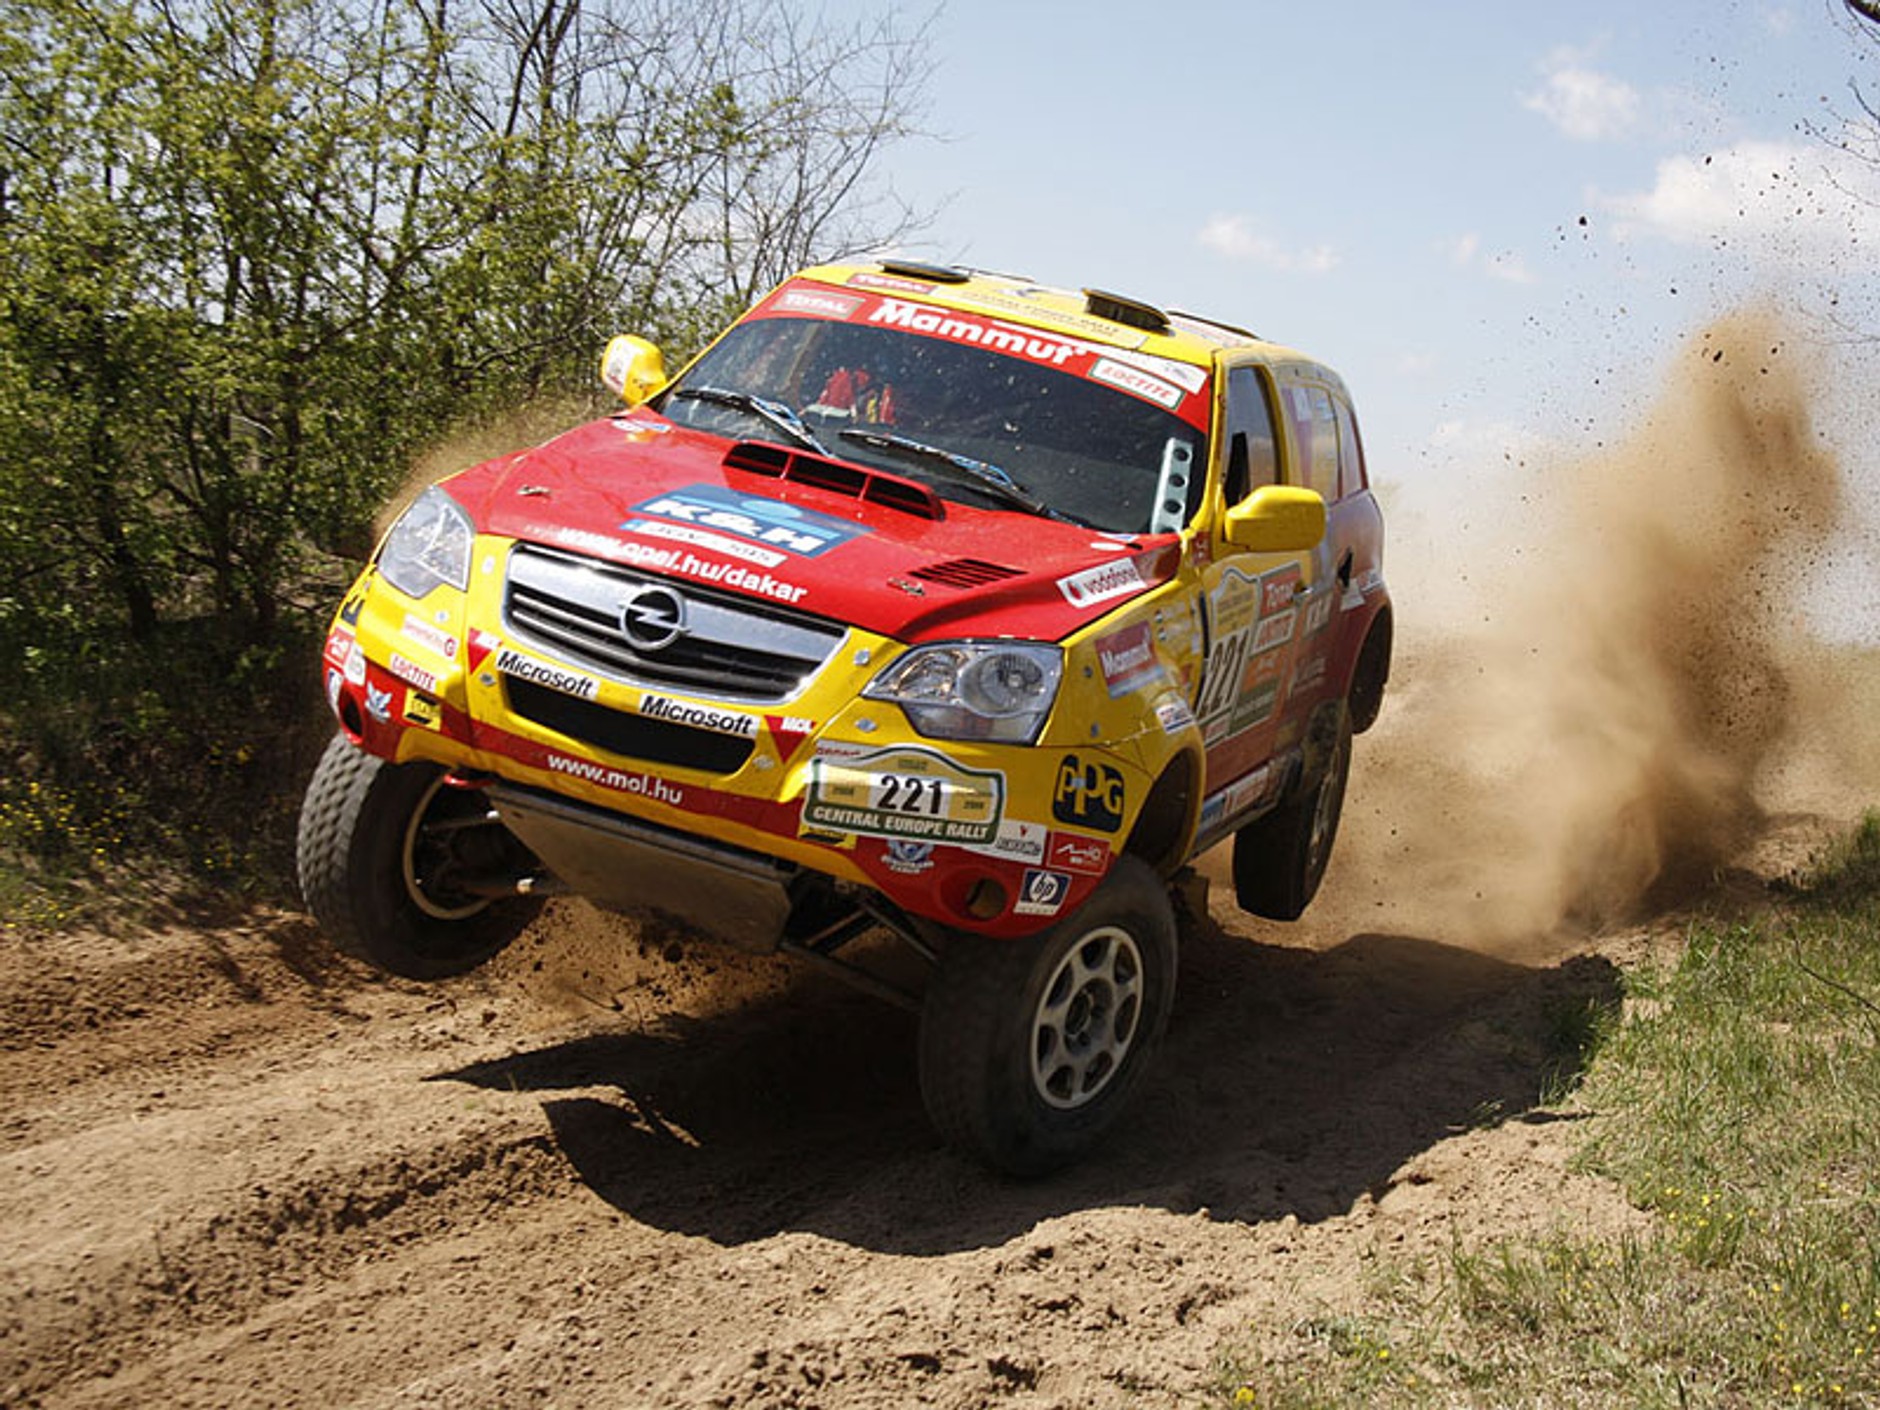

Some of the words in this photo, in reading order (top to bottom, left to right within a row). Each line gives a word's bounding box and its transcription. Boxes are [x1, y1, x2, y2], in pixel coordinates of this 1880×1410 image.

[785, 293, 848, 313] TOTAL
[868, 299, 1087, 365] Mammut
[1101, 366, 1173, 399] LOCTITE
[643, 499, 827, 553] K&H
[557, 526, 808, 603] www.opel.hu/dakar
[1084, 567, 1138, 595] vodafone
[498, 651, 593, 698] Microsoft
[1199, 629, 1249, 718] 221
[640, 696, 753, 735] Microsoft
[781, 717, 812, 732] MOL
[548, 754, 683, 804] www.mol.hu
[877, 775, 942, 814] 221
[1056, 760, 1123, 815] PPG
[813, 805, 882, 827] CENTRAL
[885, 815, 942, 836] EUROPE
[946, 823, 989, 839] RALLY
[1033, 873, 1055, 902] hp
